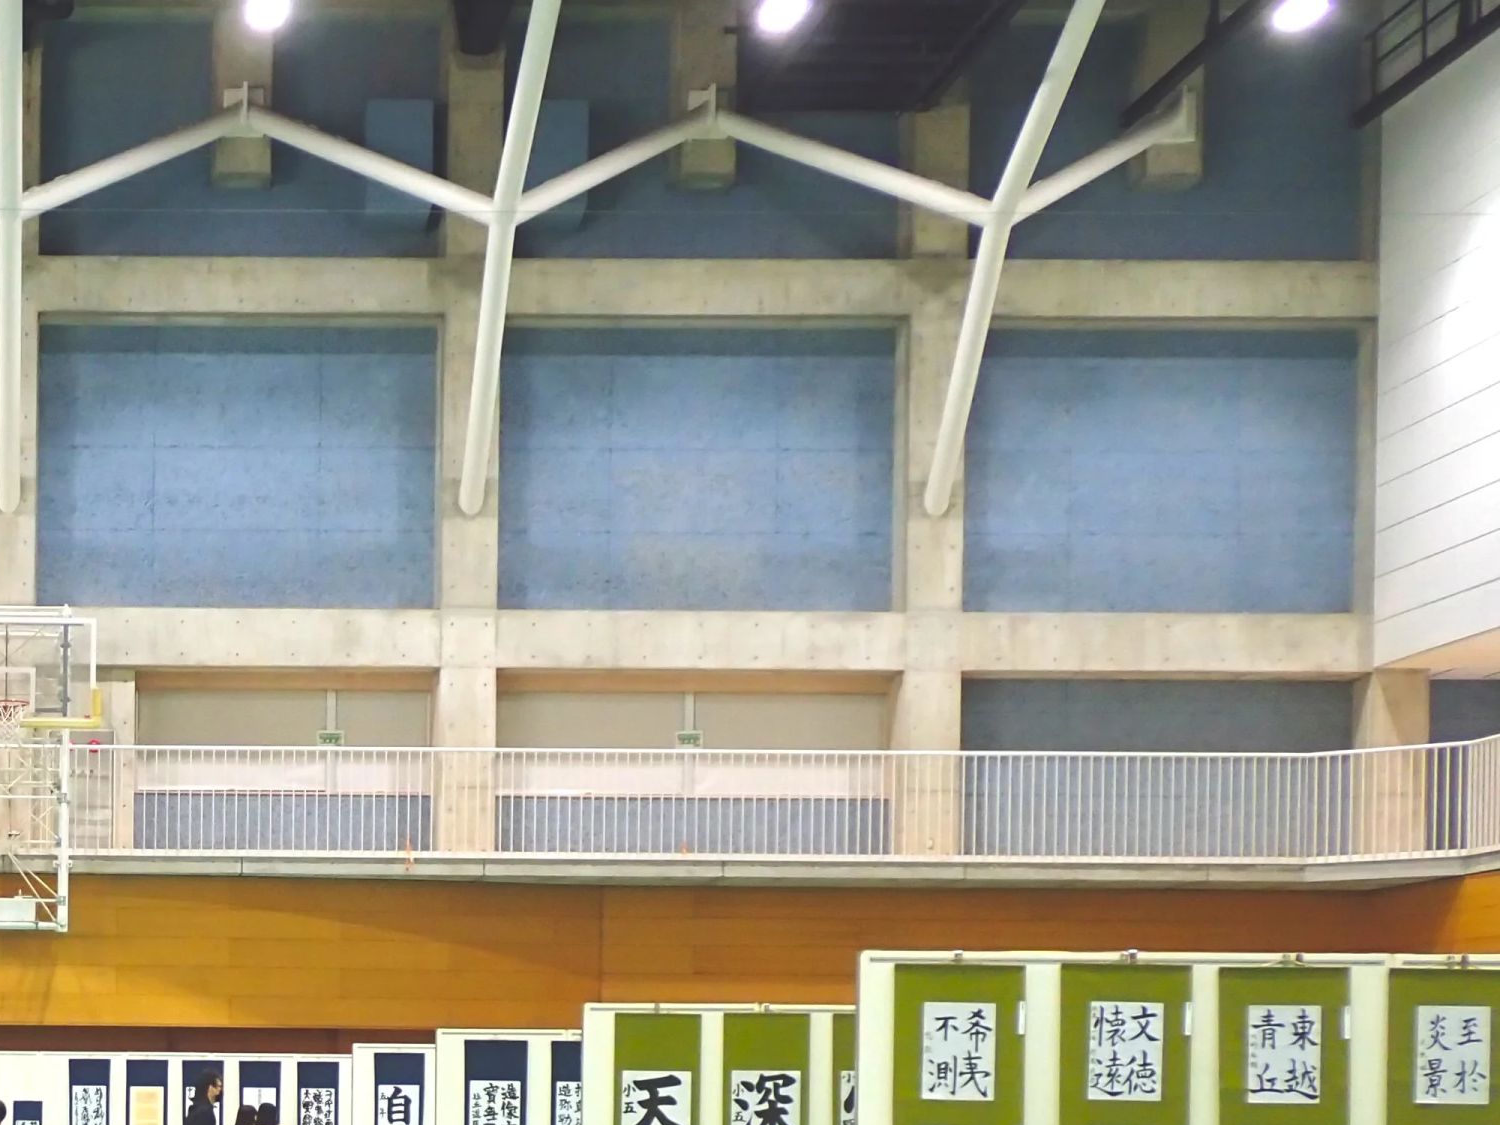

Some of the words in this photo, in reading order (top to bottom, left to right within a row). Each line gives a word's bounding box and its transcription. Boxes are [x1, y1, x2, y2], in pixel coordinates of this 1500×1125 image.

[928, 1016, 959, 1095] 不測
[1284, 1008, 1319, 1099] 東越
[1423, 1014, 1452, 1097] 炎景
[623, 1084, 637, 1114] 小五
